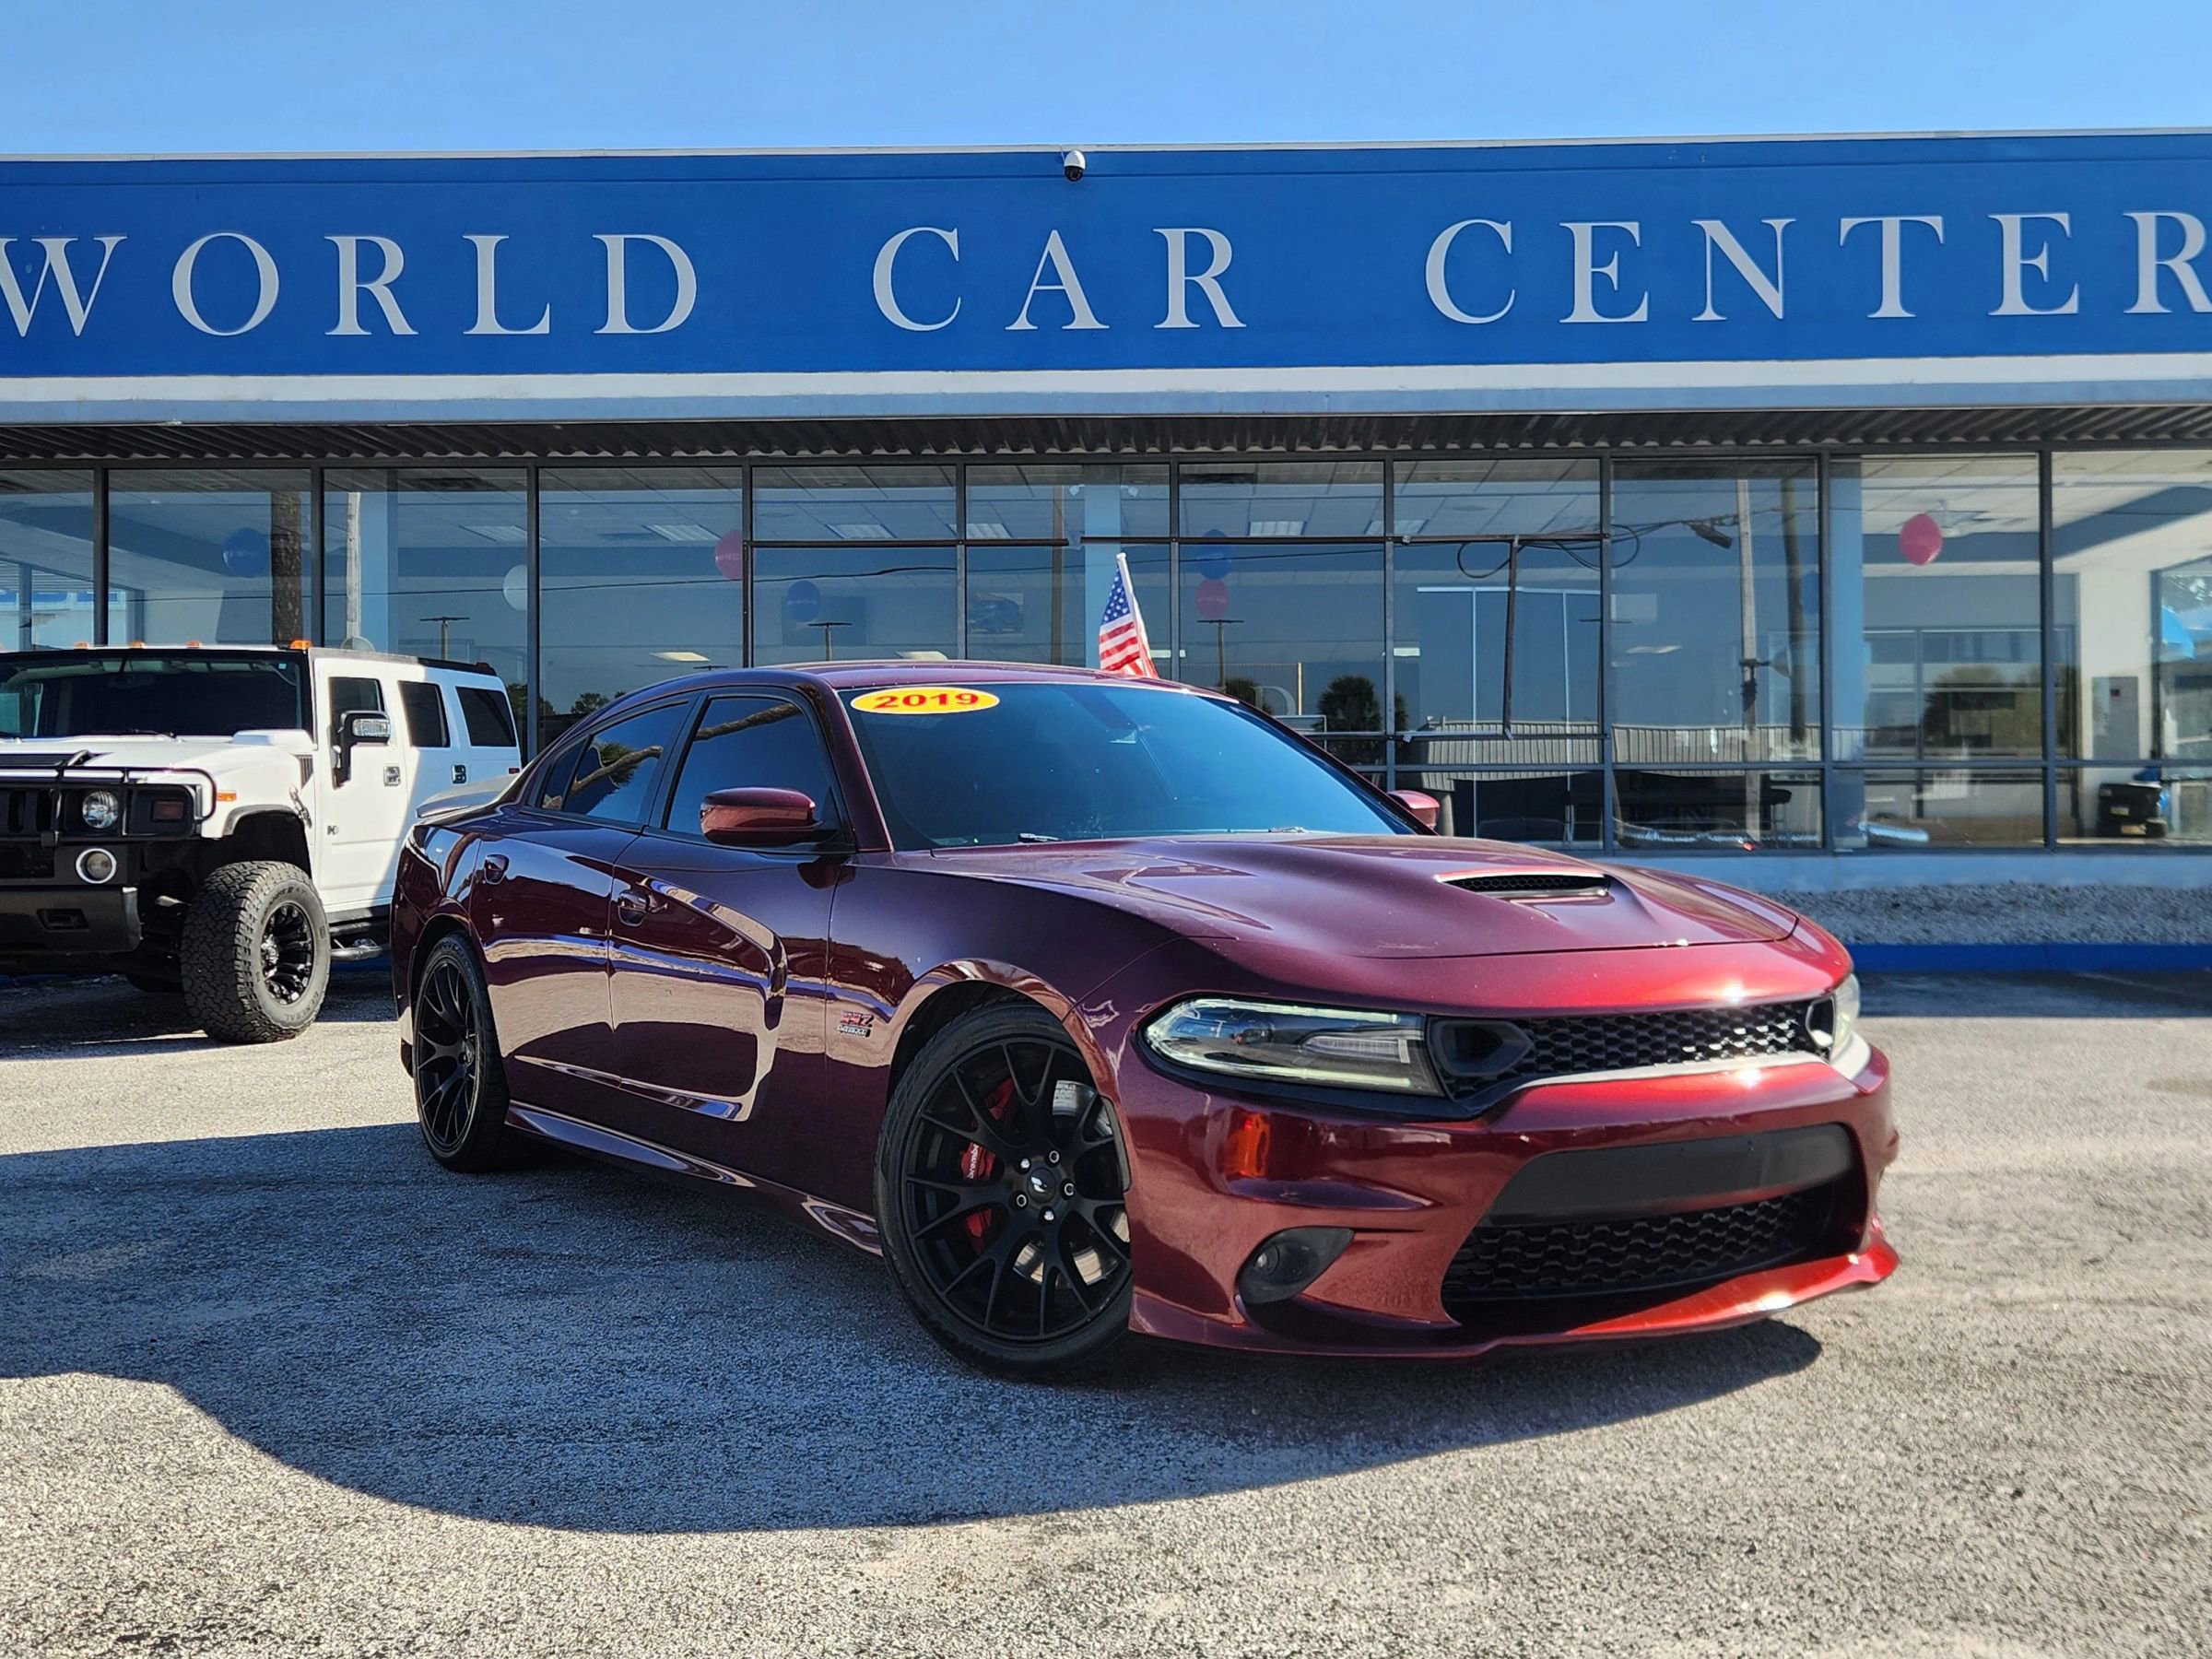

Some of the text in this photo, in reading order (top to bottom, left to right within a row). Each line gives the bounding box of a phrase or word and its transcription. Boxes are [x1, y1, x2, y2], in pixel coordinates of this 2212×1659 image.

[0, 210, 2212, 338] WORLD CAR CENTER
[873, 693, 979, 710] 2019
